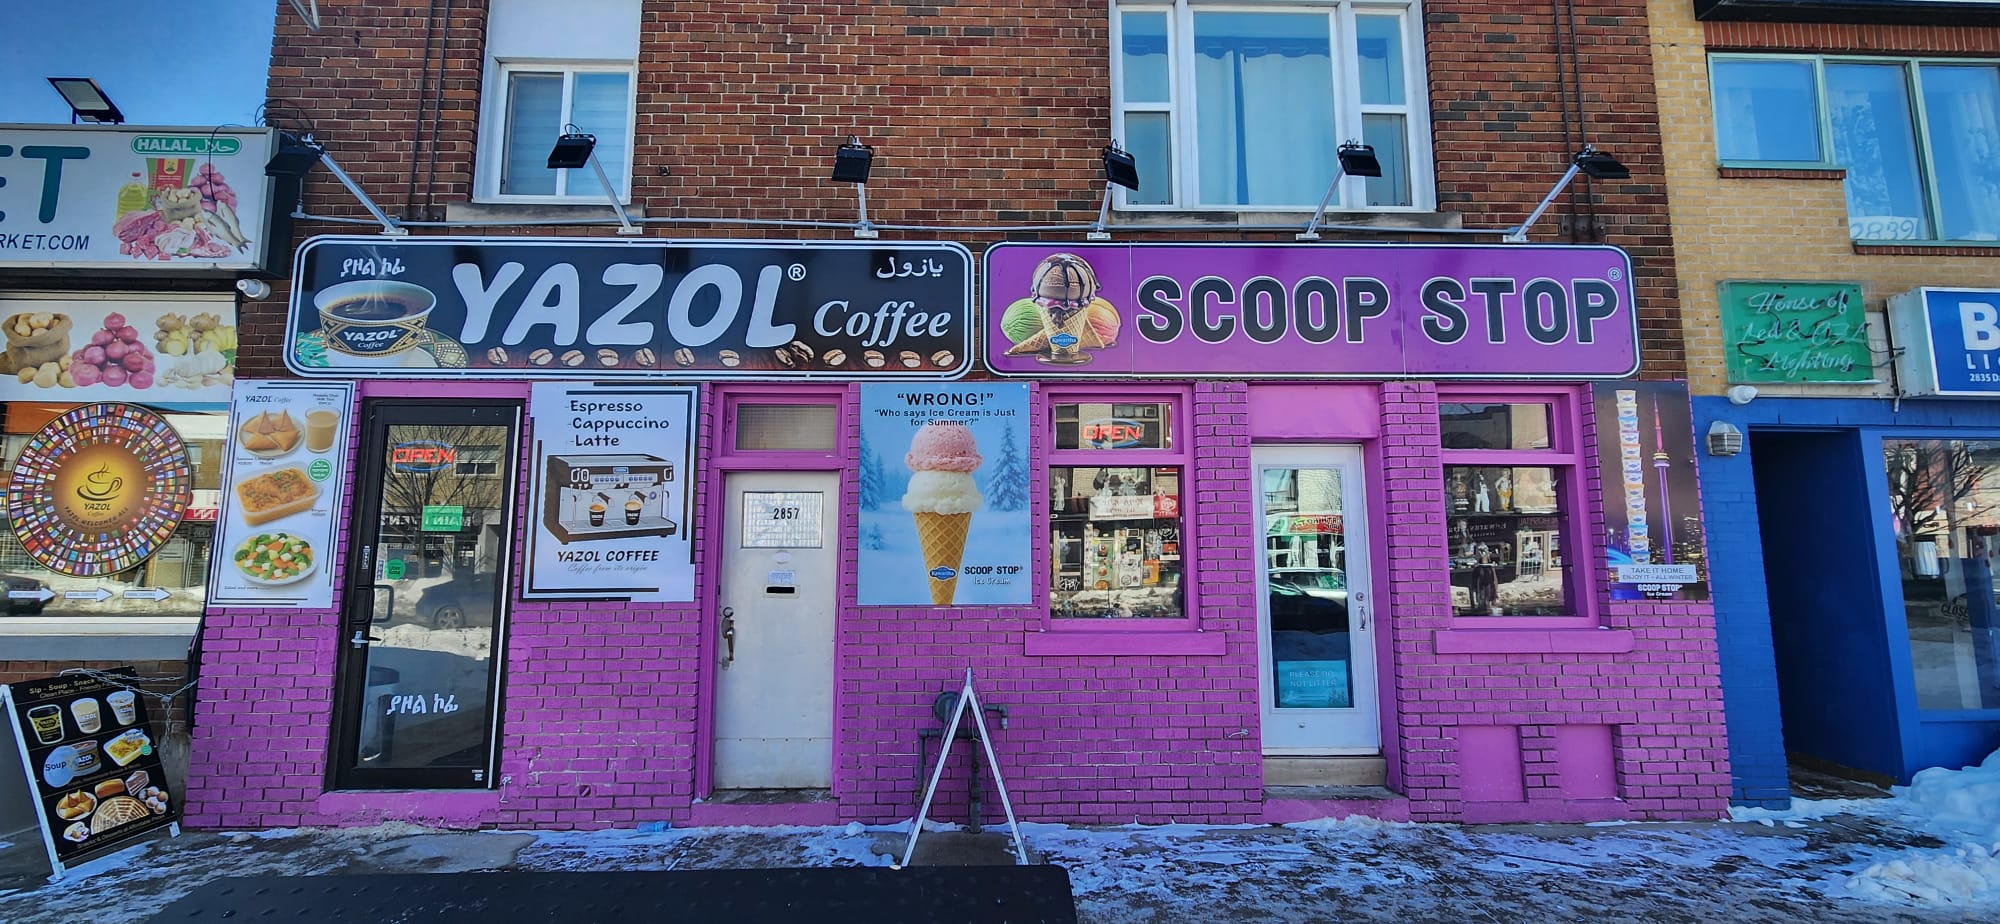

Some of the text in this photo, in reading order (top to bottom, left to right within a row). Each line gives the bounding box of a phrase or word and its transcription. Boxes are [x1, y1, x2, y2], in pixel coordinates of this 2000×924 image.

[137, 139, 191, 151] HALAL
[195, 138, 235, 152] حلال
[0, 145, 90, 224] T
[876, 256, 944, 279] يازول
[1748, 288, 1848, 314] House of
[1136, 275, 1391, 345] SCOOP
[813, 300, 952, 347] Coffee
[1958, 302, 2000, 351] B
[1741, 321, 1783, 342] Led
[1786, 319, 1803, 341] &
[357, 341, 385, 350] Coffee
[1759, 350, 1856, 378] Lighting
[1966, 353, 2000, 370] LI
[1969, 373, 2000, 382] 2835 D
[903, 410, 926, 418] says
[929, 409, 943, 417] Ice
[947, 409, 979, 417] Cream
[982, 409, 991, 417] is
[993, 409, 1016, 417] Just
[910, 418, 925, 426] for
[1082, 425, 1142, 441] OPEN
[392, 447, 455, 463] OPEN
[83, 503, 111, 511] YAZOL
[773, 508, 800, 520] 2857
[557, 550, 660, 562] YAZOL COFFEE
[964, 566, 993, 575] SCOOP
[974, 575, 985, 585] Ice
[1637, 583, 1660, 591] SCOOP
[29, 687, 42, 695] Sip
[48, 683, 68, 692] Soup
[45, 761, 67, 772] Soup
